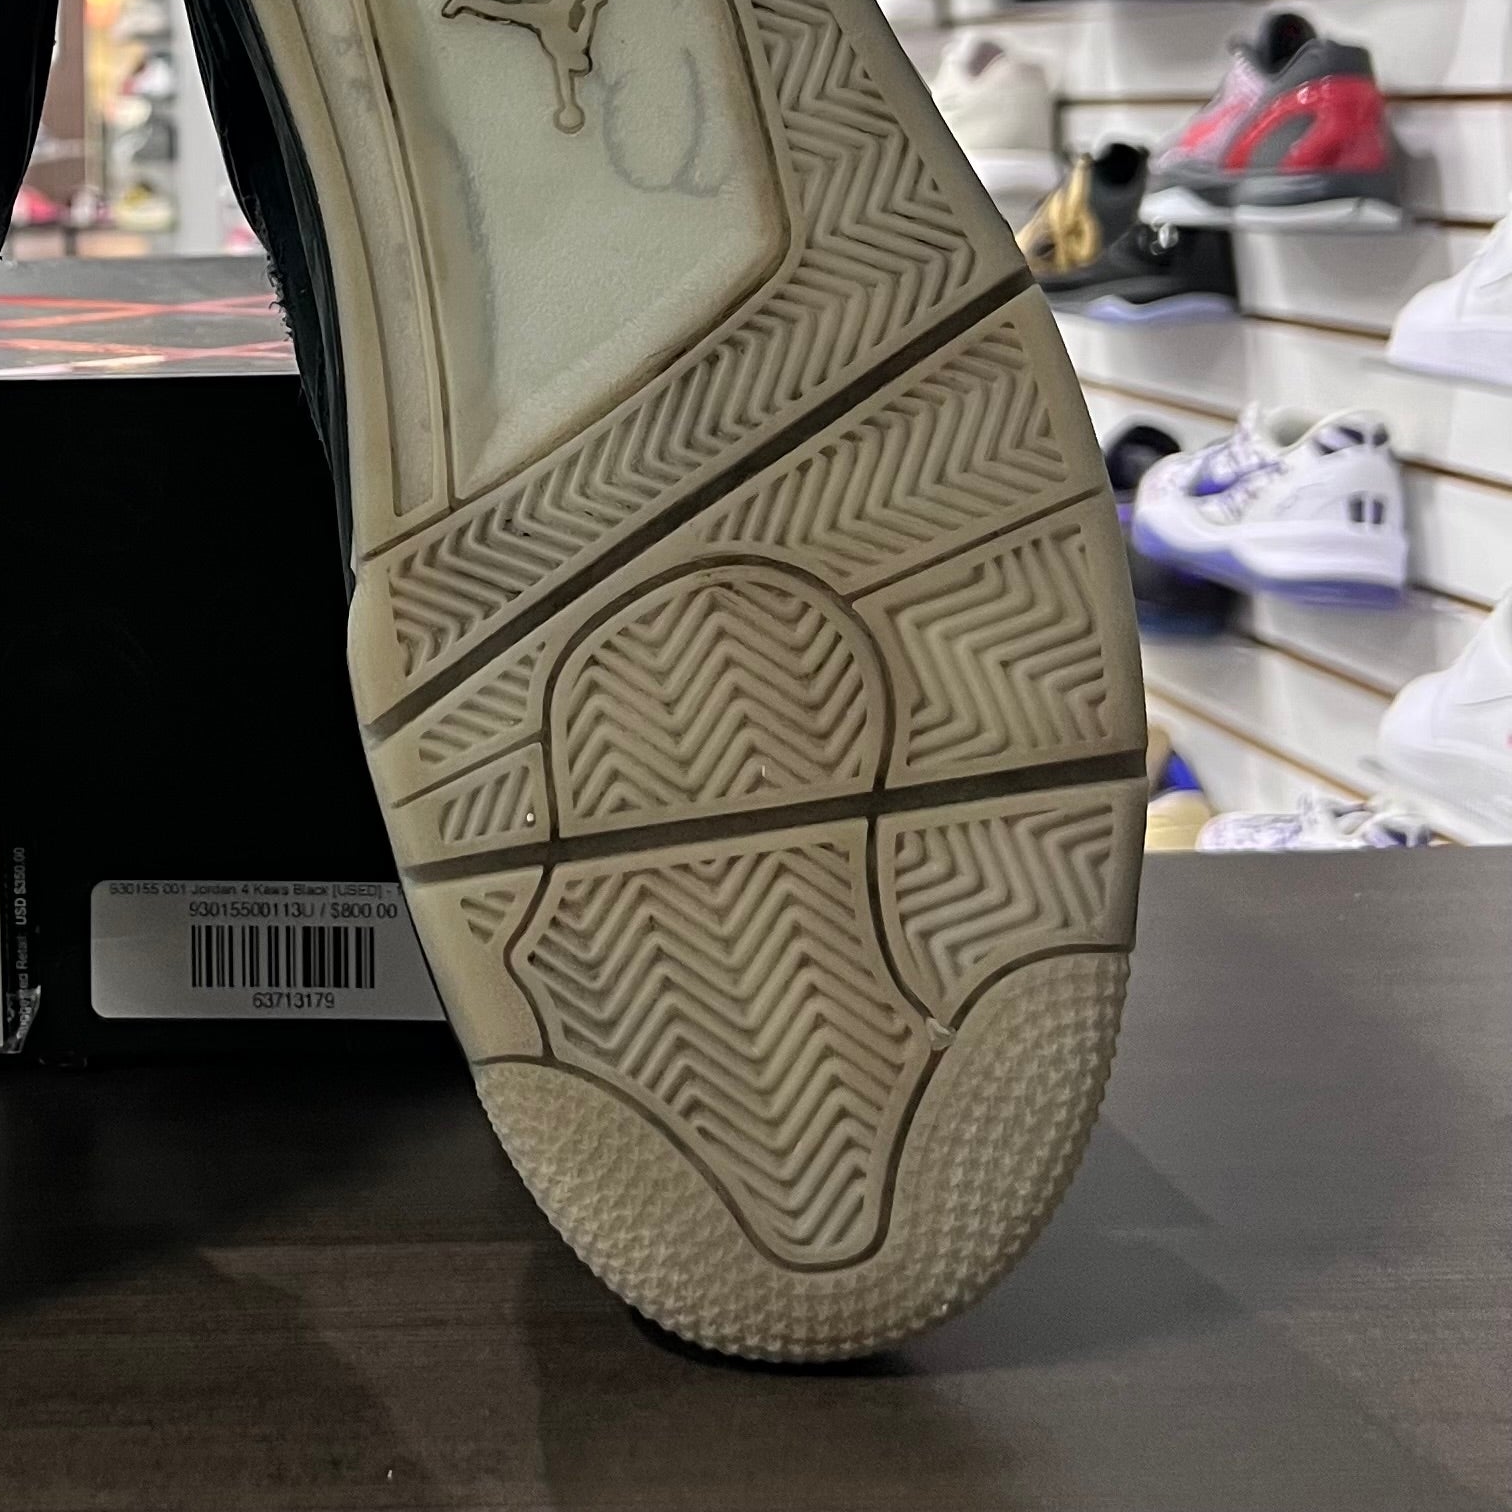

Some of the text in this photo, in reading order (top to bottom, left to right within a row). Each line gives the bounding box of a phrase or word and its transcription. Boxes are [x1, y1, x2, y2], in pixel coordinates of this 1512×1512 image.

[13, 847, 26, 895] $350.00
[241, 884, 249, 896] 4
[332, 884, 382, 900] [USED]
[15, 897, 27, 925] USD
[252, 991, 335, 1009] 63713179
